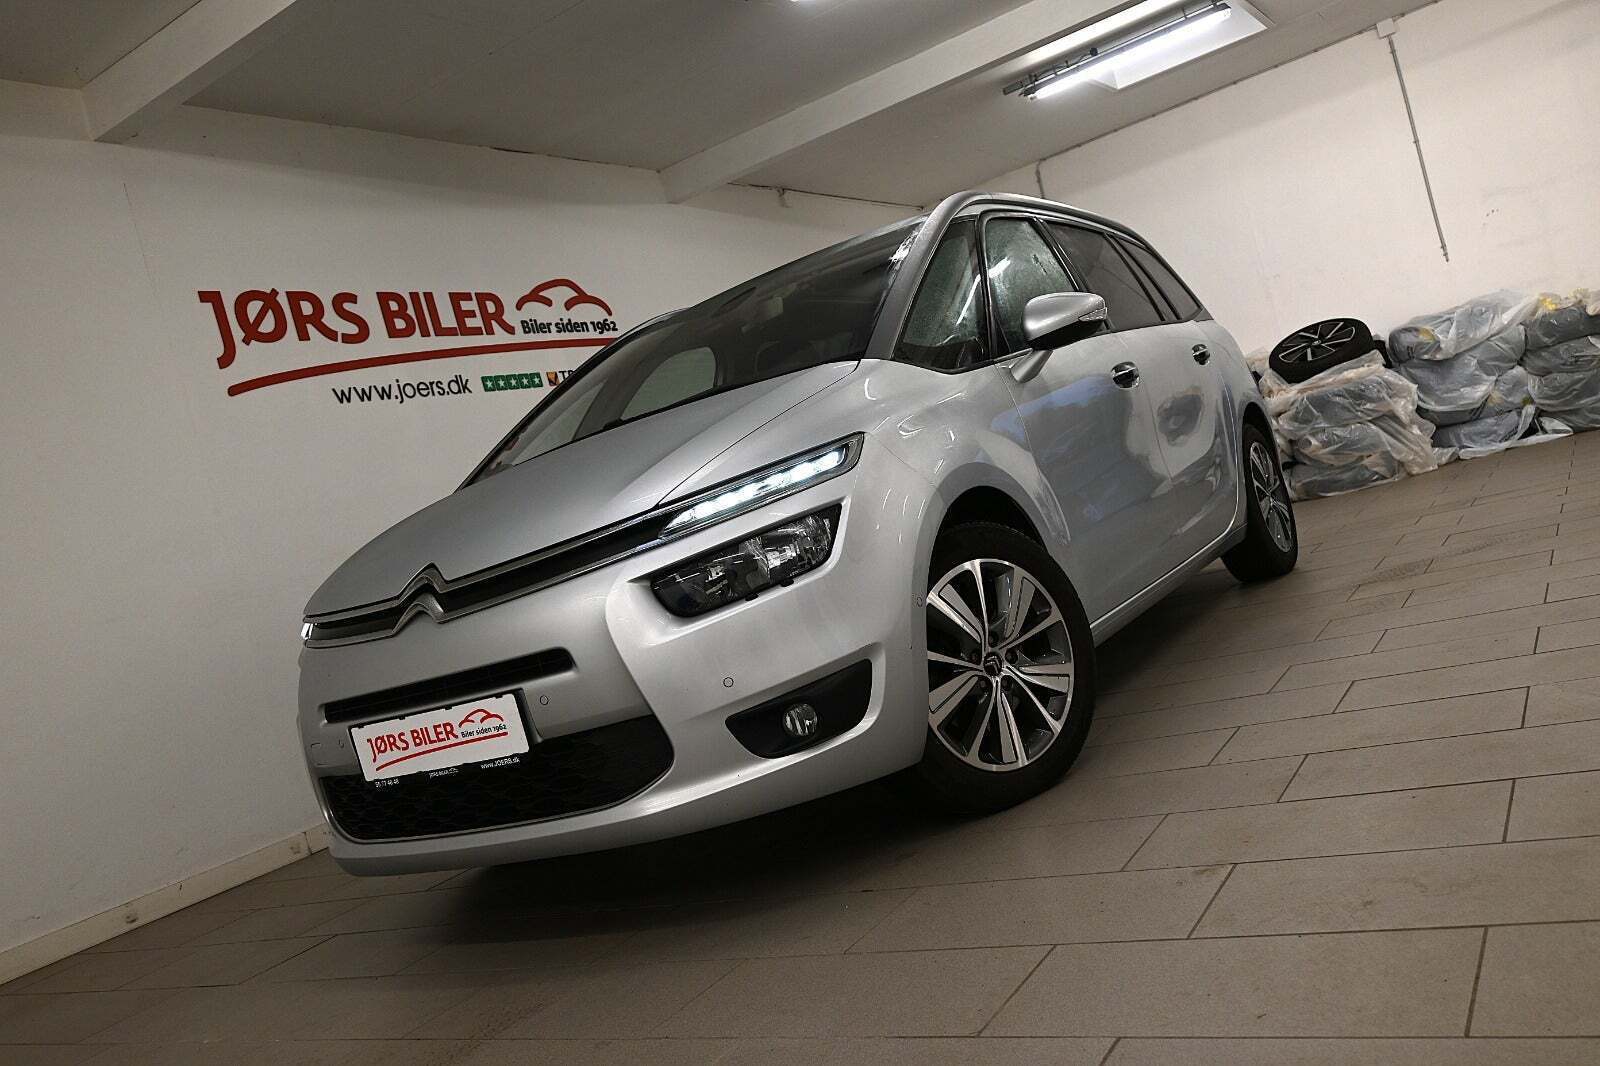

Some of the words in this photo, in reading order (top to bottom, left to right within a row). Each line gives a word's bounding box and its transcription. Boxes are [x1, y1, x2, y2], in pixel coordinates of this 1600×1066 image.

[198, 288, 370, 370] JØRS
[376, 291, 515, 339] BILER
[521, 317, 553, 335] Biler
[555, 317, 590, 334] siden
[590, 318, 619, 335] 1962
[332, 374, 473, 404] www.joers.dk
[366, 731, 410, 763] JØRS
[410, 721, 459, 748] BILER
[475, 726, 492, 736] siden
[492, 723, 508, 733] 1962
